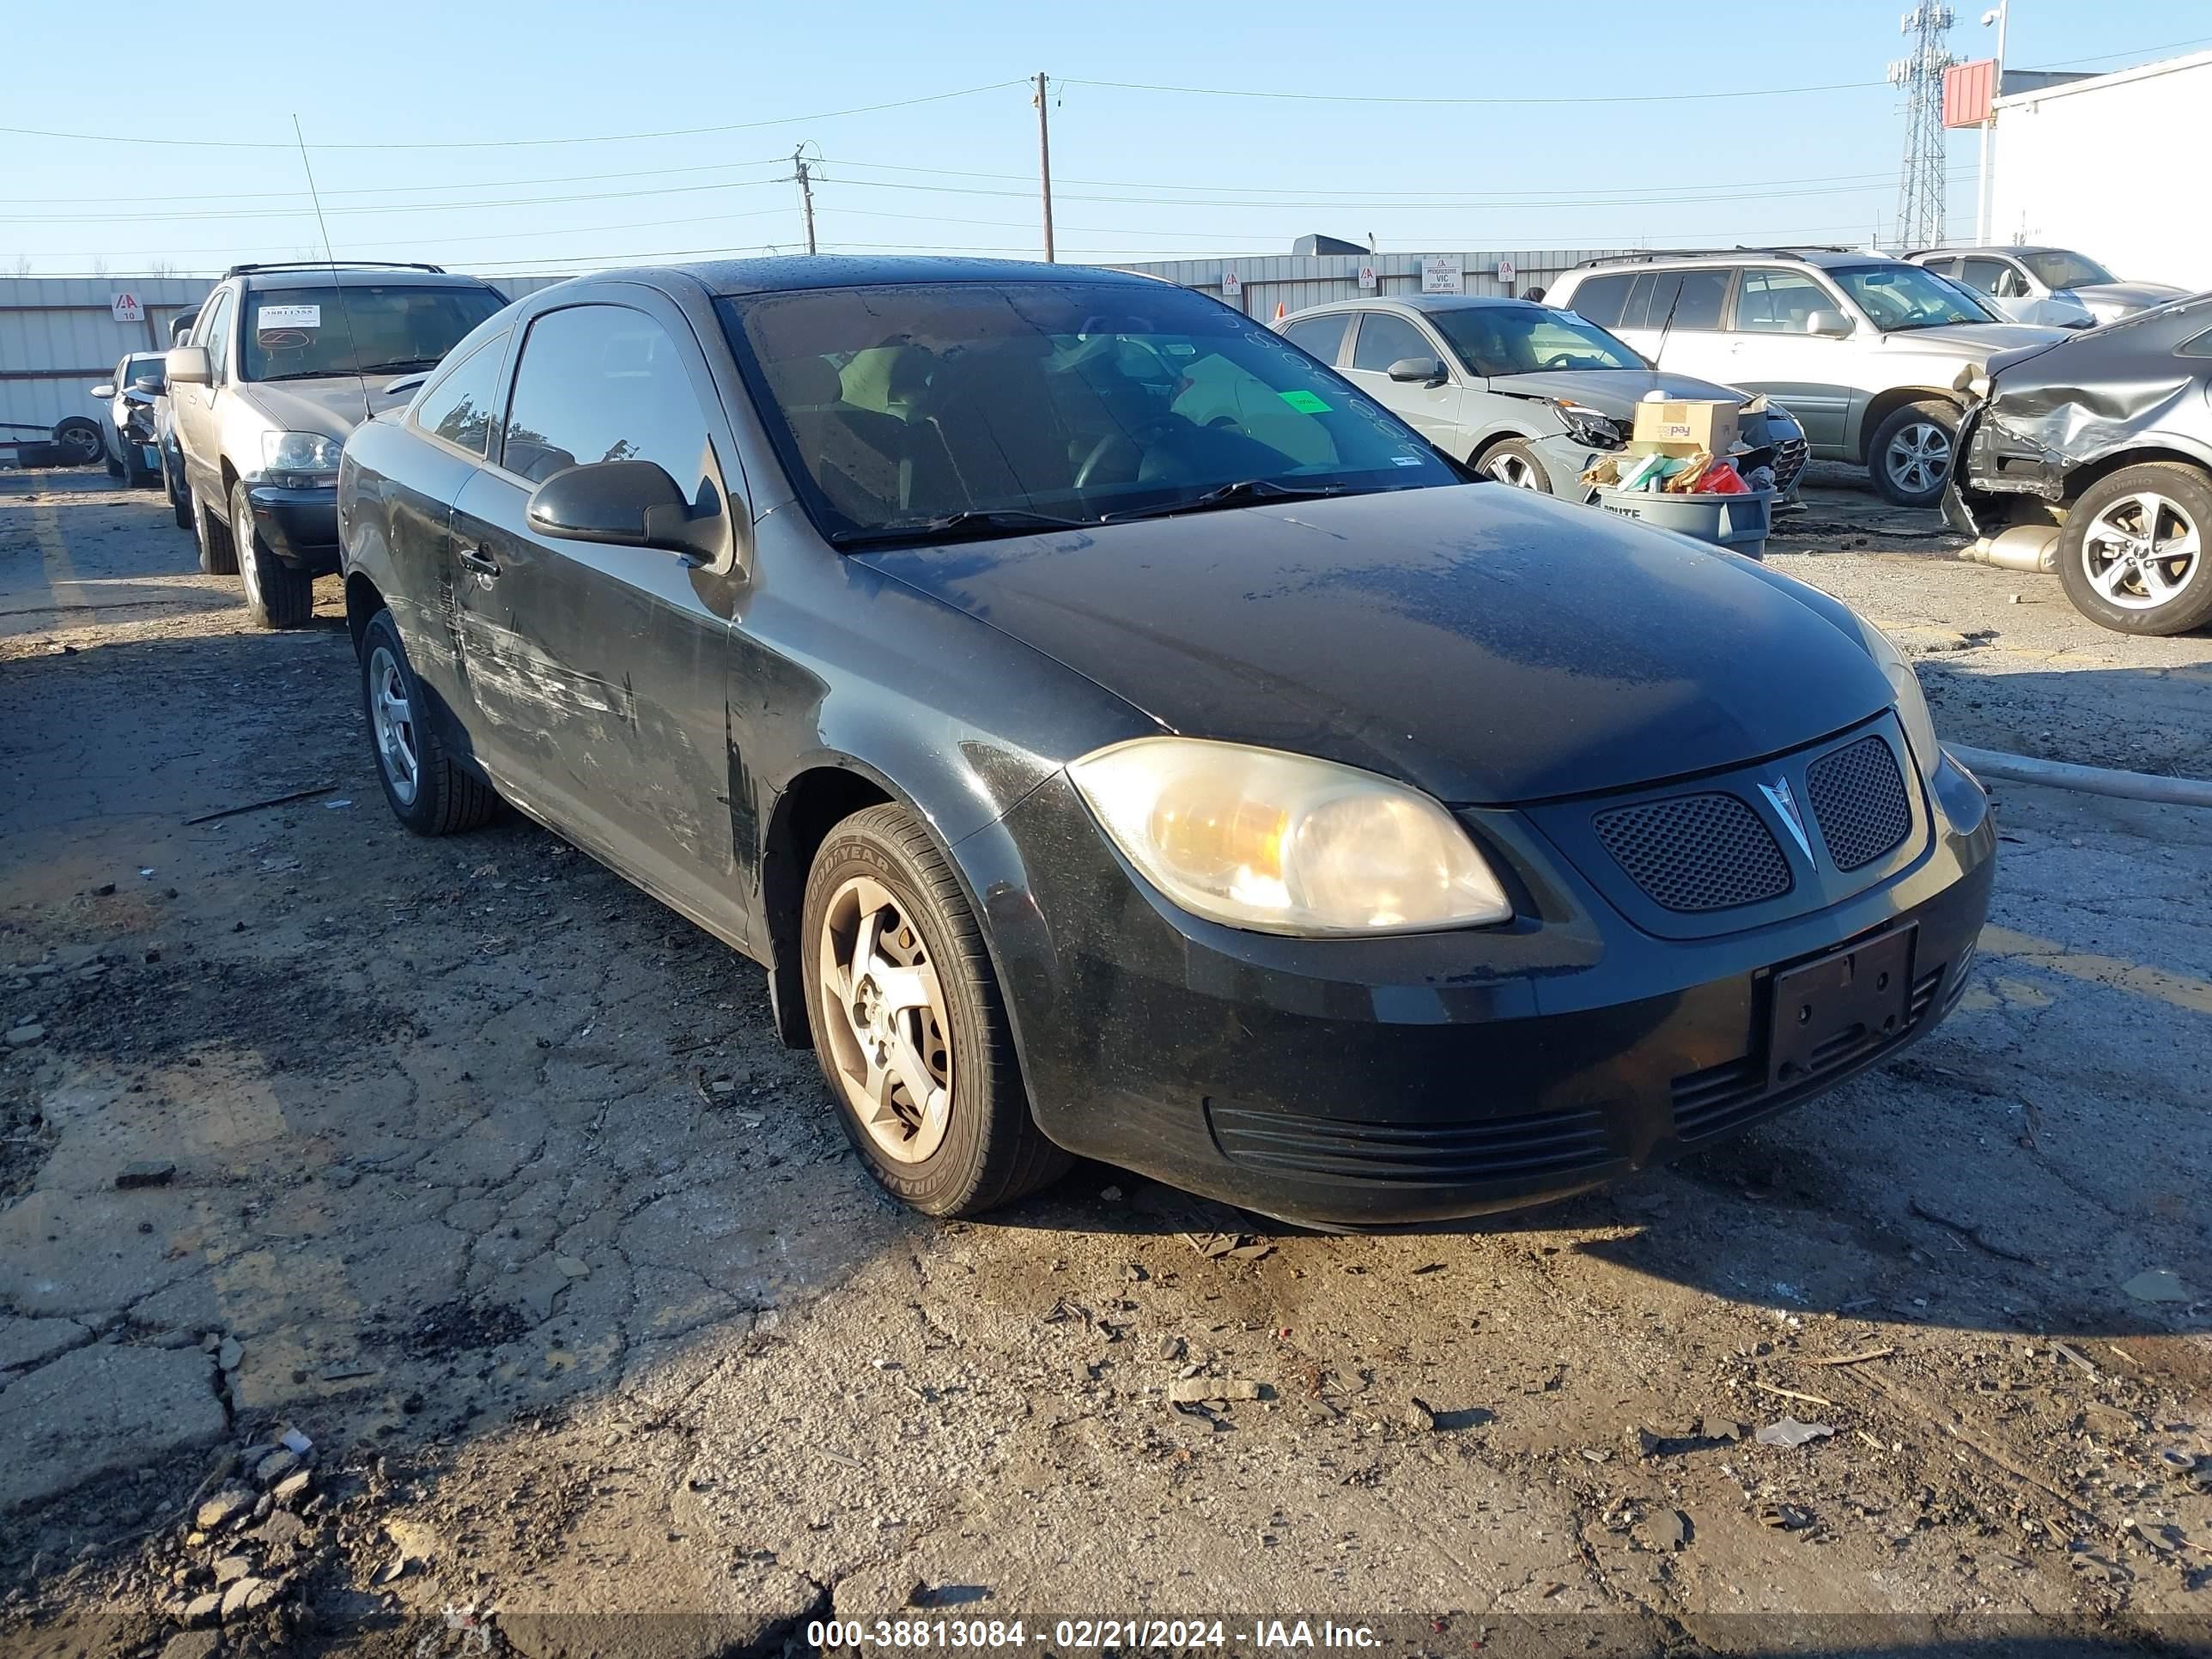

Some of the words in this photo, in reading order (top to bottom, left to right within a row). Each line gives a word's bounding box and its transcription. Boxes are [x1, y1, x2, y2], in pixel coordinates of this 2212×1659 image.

[1437, 274, 1449, 283] VIC
[2102, 478, 2153, 496] KUMHO
[807, 843, 890, 921] GOODYEAR
